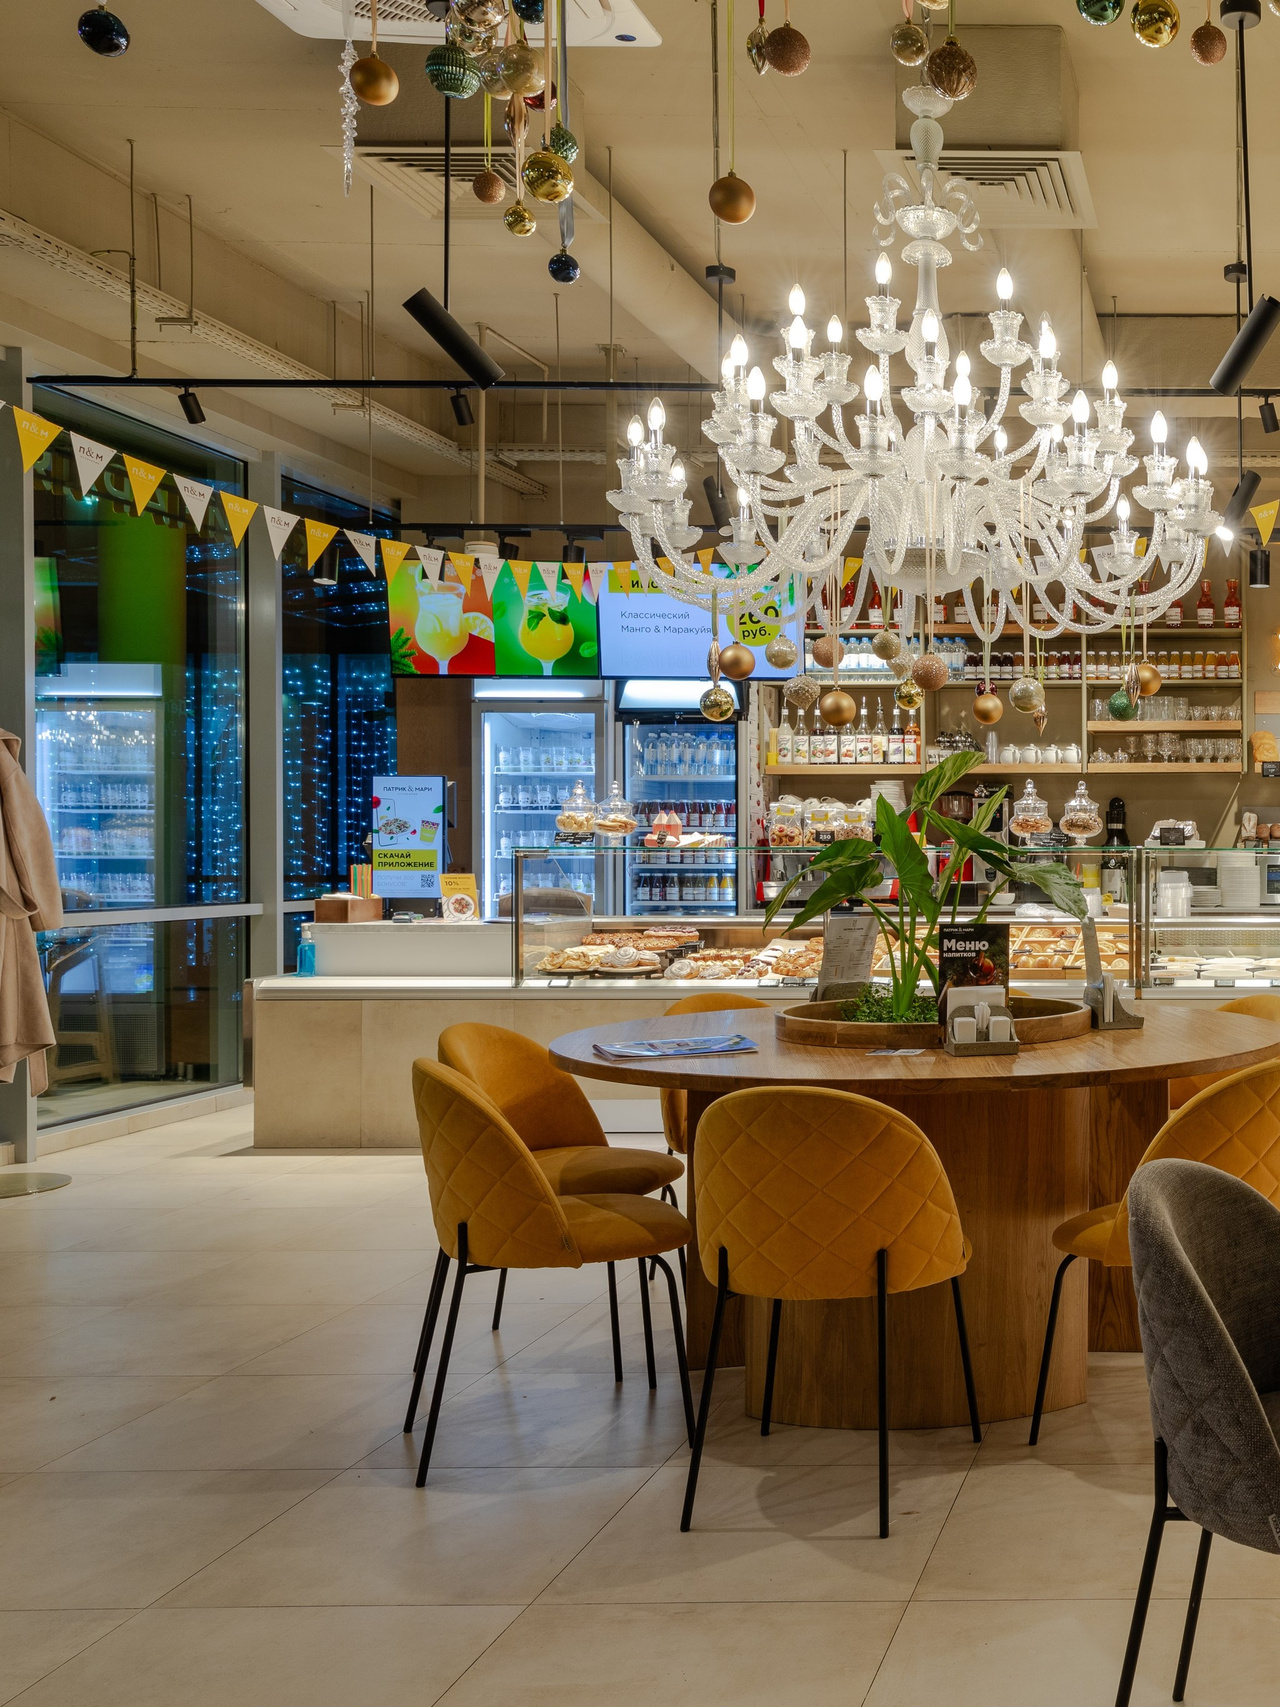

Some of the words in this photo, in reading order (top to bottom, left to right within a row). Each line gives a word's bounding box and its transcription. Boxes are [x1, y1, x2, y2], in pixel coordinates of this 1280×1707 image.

[620, 611, 690, 619] Классический
[621, 625, 651, 633] Манго
[653, 625, 661, 633] &
[663, 625, 712, 635] Маракуйя
[742, 626, 771, 640] руб.
[377, 851, 411, 859] СКАЧАЙ
[943, 939, 989, 951] Меню
